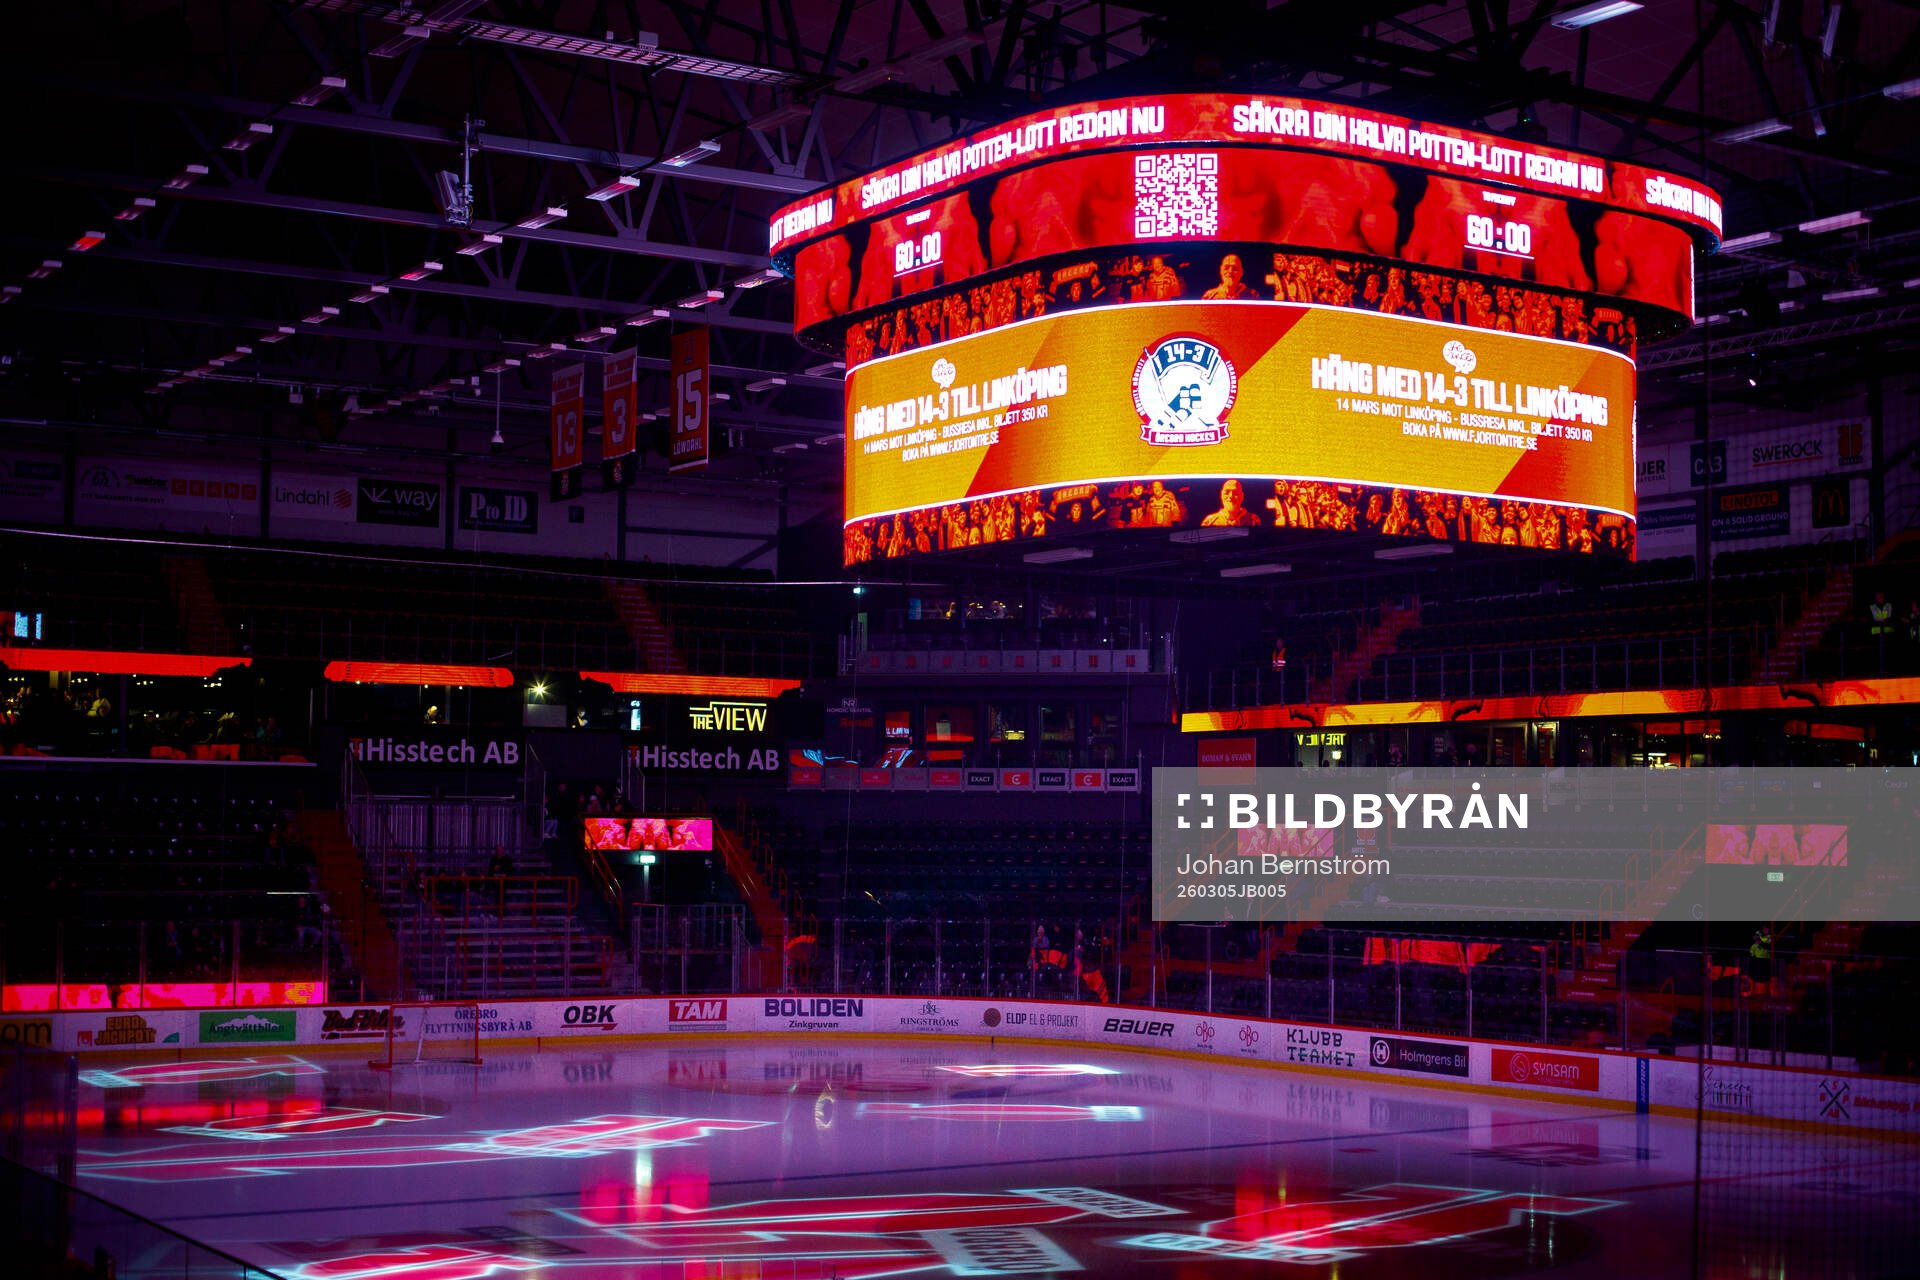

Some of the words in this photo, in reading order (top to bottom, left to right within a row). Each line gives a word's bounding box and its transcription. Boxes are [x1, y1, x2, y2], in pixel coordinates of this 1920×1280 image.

[1059, 108, 1127, 143] REDAN
[1131, 105, 1164, 134] NU
[1233, 100, 1309, 136] SÄKRA
[1313, 112, 1347, 144] DIN
[1349, 117, 1406, 153] HALVA
[1409, 129, 1523, 178] POTTEN-LOTT
[1525, 153, 1579, 188] REDAN
[1580, 159, 1603, 192] NU
[1467, 214, 1531, 254] 60:00
[895, 240, 941, 273] 60:00
[1164, 342, 1205, 362] 14-3
[676, 368, 702, 434] 15
[886, 398, 915, 432] MED
[917, 390, 950, 426] 14-3
[952, 384, 981, 417] TILL
[982, 364, 1067, 411] LINKÖPING
[1376, 364, 1421, 400] MED
[1424, 371, 1467, 406] 14-3
[1470, 378, 1512, 413] TILL
[1516, 385, 1608, 426] LINKÖPING
[611, 398, 626, 444] 3
[1021, 408, 1035, 422] 350
[1036, 405, 1048, 419] KR
[1336, 398, 1349, 411] 14
[1352, 399, 1379, 414] MARS
[1381, 401, 1403, 417] MOT
[1405, 403, 1452, 424] LINKÖPING
[1460, 414, 1506, 431] BUSSRESA
[1531, 420, 1563, 437] BILJETT
[1565, 425, 1580, 440] 350
[1581, 428, 1593, 442] KR
[556, 409, 577, 457] 13
[1403, 421, 1428, 437] BOKA
[1429, 422, 1442, 439] PÅ
[1752, 440, 1823, 463] SWEROCK
[275, 487, 330, 506] Lindahl
[394, 487, 438, 513] way
[503, 491, 528, 522] ID
[1754, 511, 1789, 523] GROUND
[691, 713, 713, 731] THE
[712, 707, 767, 731] VIEW
[366, 737, 476, 764] Hisstech
[483, 741, 520, 764] AB
[642, 744, 741, 770] Hisstech
[747, 748, 779, 770] AB
[564, 1005, 615, 1024] OBK
[674, 1001, 722, 1020] TAM
[765, 999, 863, 1017] BOLIDEN
[518, 1020, 533, 1031] AB
[789, 1020, 839, 1030] Zinkgruvan
[900, 1015, 959, 1027] RINGSTRÖMS
[1006, 1012, 1027, 1024] ELOP
[1029, 1013, 1038, 1025] EL
[1040, 1014, 1046, 1025] &
[1047, 1014, 1078, 1028] PROJEKT
[1287, 1027, 1343, 1047] KLUBB
[1287, 1046, 1355, 1067] TEAMET
[1400, 1048, 1452, 1067] Holmgrens
[1454, 1053, 1466, 1068] Bil
